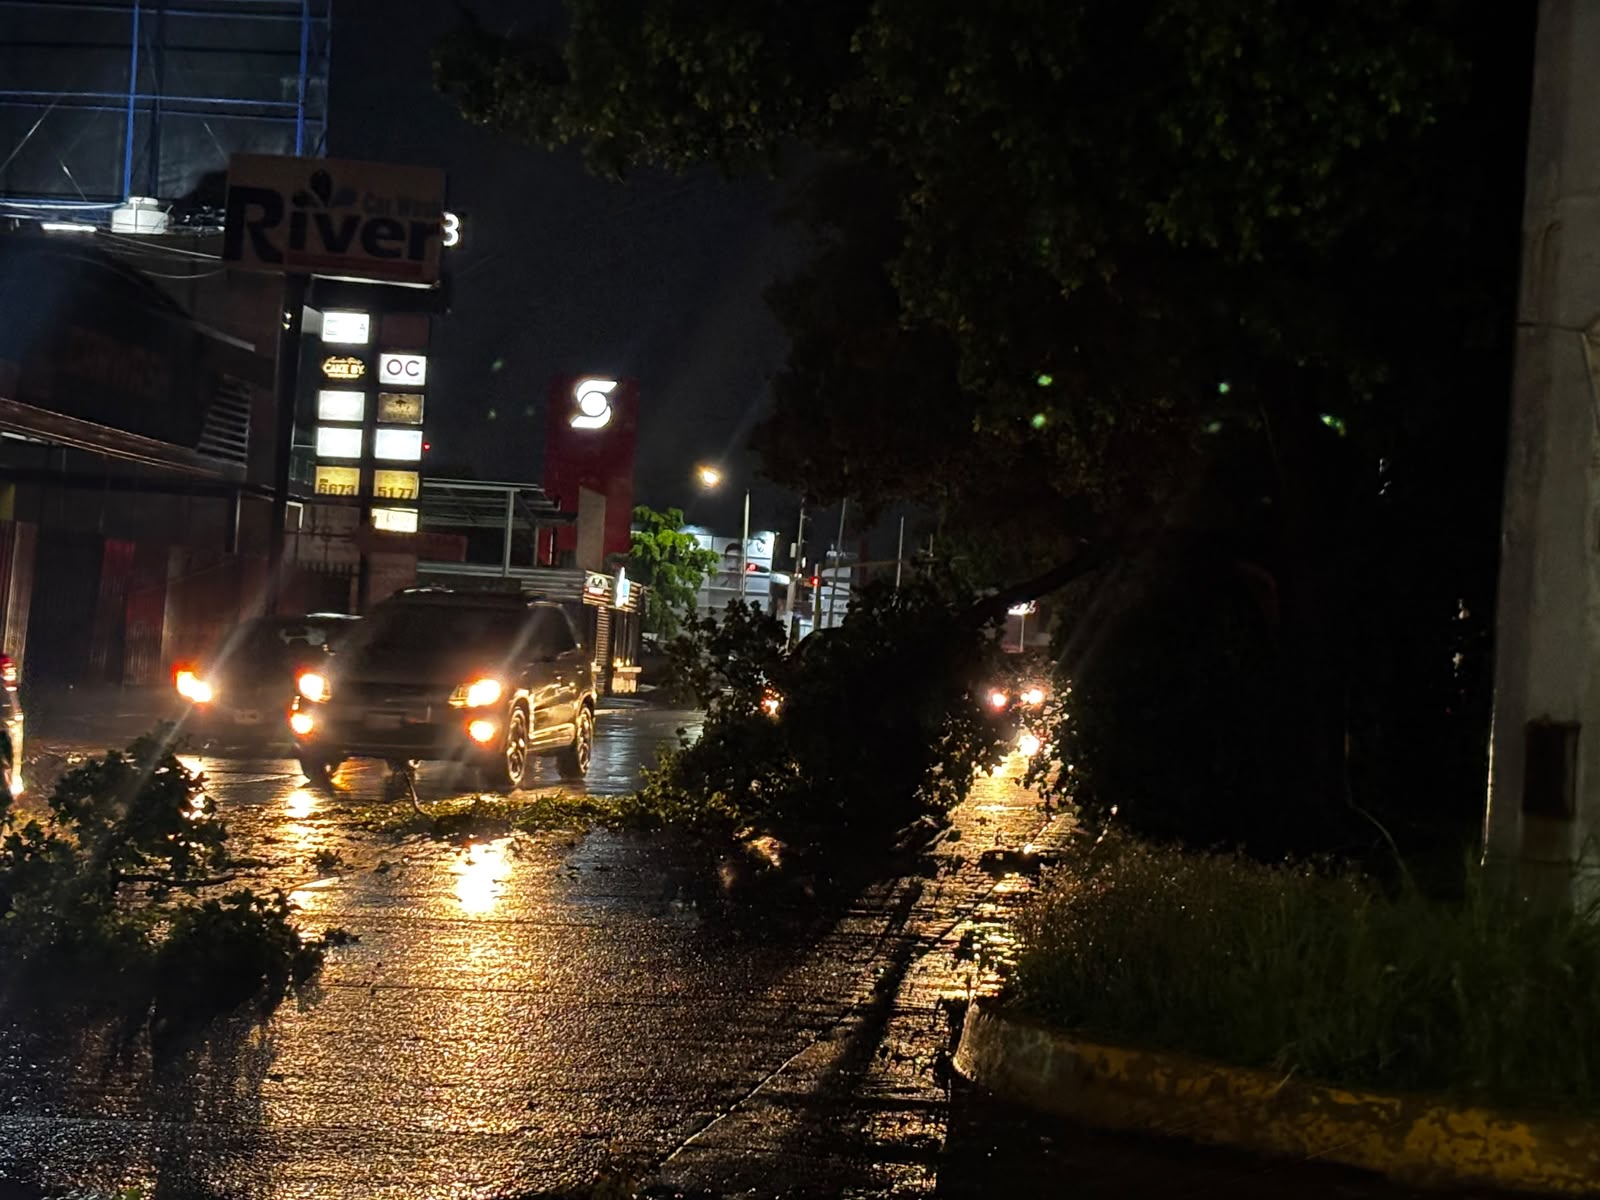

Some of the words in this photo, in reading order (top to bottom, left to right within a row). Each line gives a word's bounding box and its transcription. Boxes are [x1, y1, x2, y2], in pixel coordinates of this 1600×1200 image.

[224, 185, 440, 264] River
[322, 362, 349, 374] CAKE
[386, 358, 420, 377] OC
